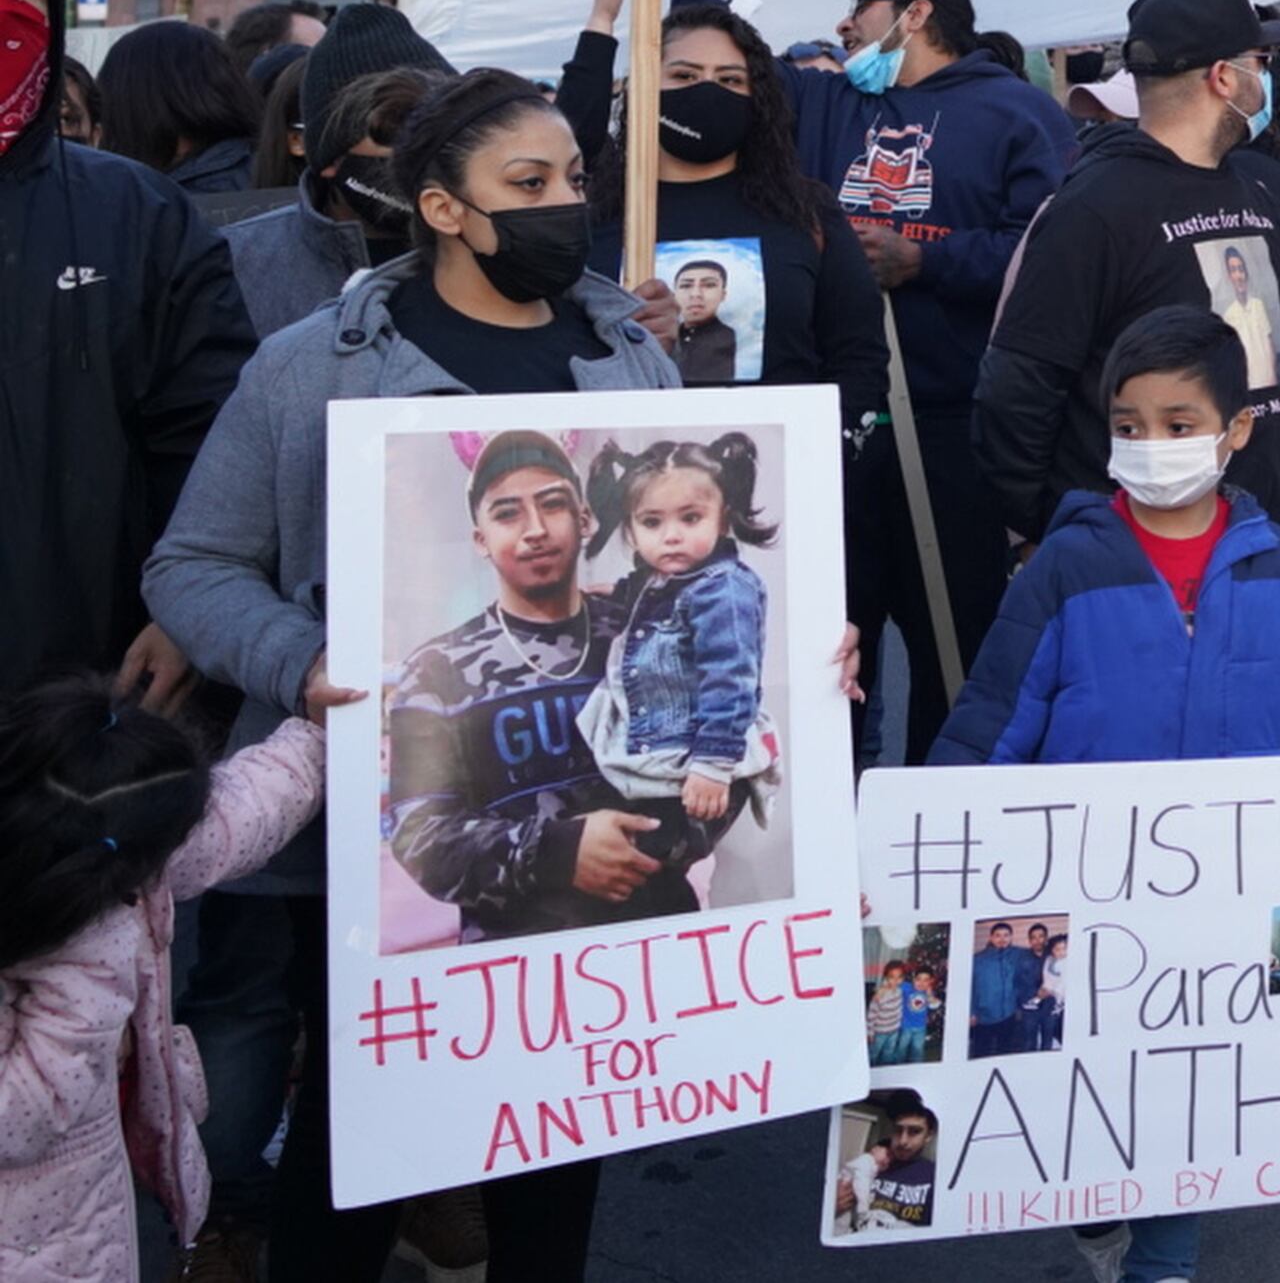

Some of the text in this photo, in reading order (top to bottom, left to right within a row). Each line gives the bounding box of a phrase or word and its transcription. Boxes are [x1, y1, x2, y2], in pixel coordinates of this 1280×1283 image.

[1162, 214, 1219, 243] Justice
[359, 908, 835, 1067] #JUSTICE
[1083, 923, 1274, 1037] Para
[482, 1059, 774, 1172] ANTHONY
[1174, 1167, 1223, 1208] BY
